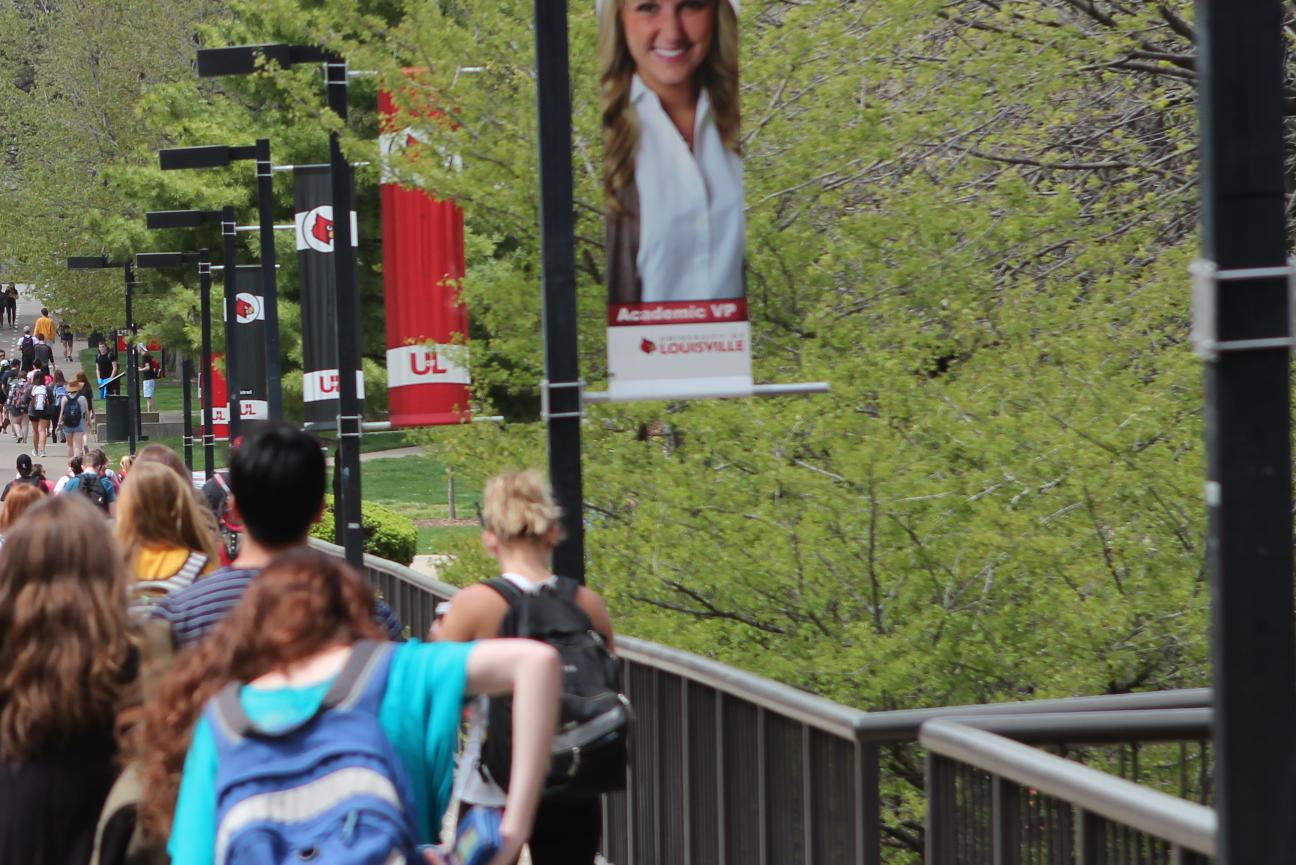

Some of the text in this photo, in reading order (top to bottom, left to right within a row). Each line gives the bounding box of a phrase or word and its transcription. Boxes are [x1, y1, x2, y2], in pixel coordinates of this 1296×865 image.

[616, 302, 737, 322] Academic VP
[659, 340, 744, 354] LOUISVILLE
